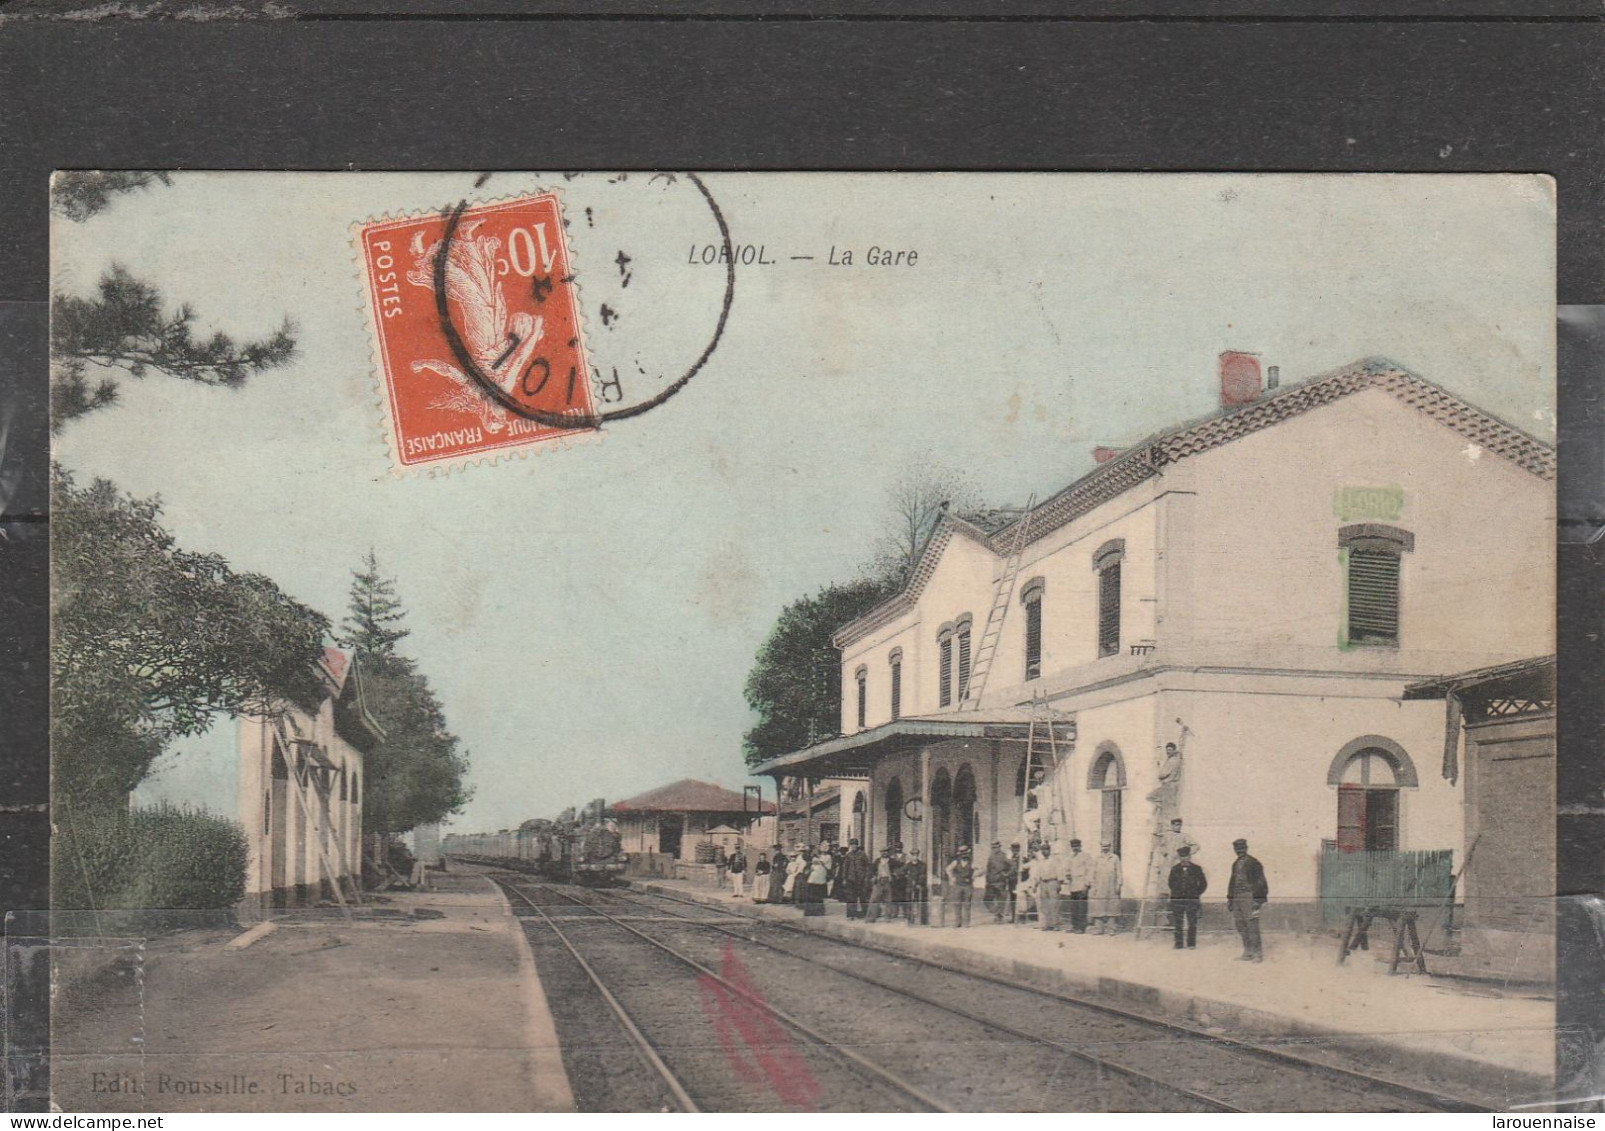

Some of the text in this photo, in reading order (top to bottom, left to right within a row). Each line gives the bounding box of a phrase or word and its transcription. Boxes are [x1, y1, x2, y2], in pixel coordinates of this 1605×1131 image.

[828, 245, 853, 266] La
[866, 245, 919, 267] Gare
[373, 241, 402, 318] POSTES
[407, 426, 483, 455] FRANÇAISE
